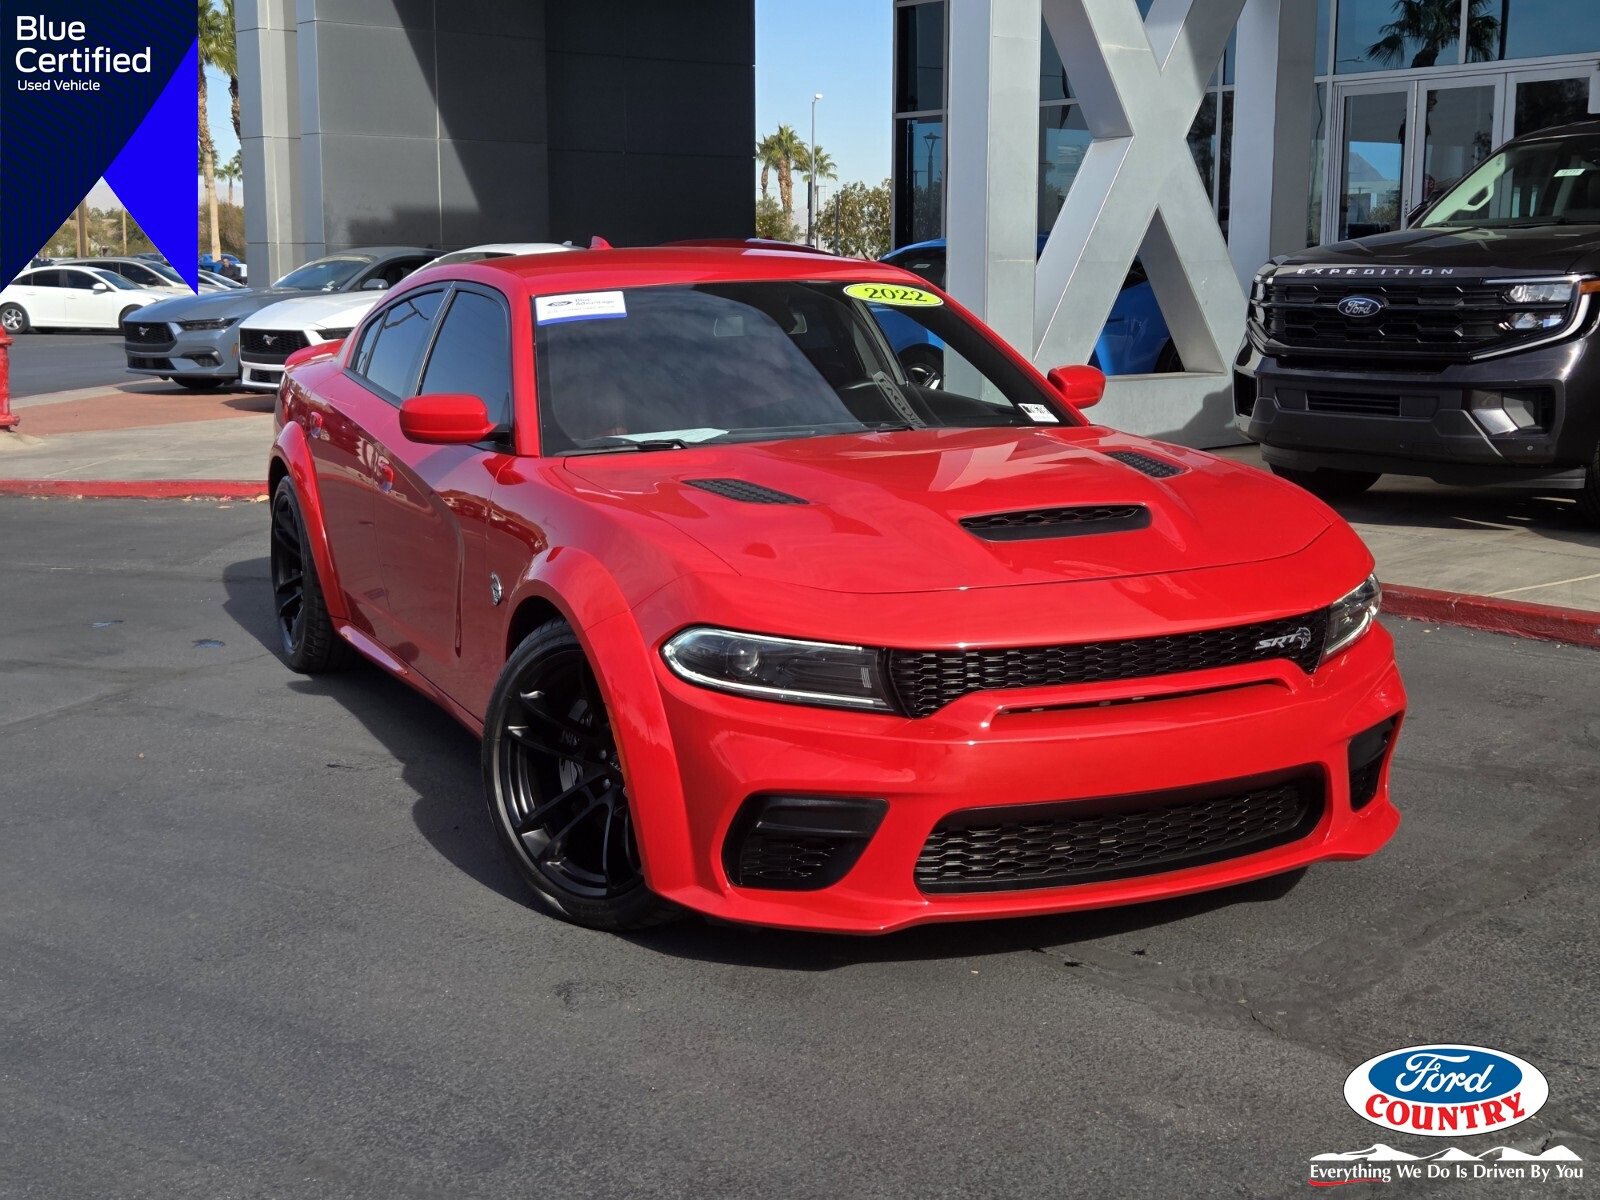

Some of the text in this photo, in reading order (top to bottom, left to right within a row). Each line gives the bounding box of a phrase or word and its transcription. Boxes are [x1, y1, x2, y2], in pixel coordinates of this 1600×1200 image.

[864, 287, 928, 302] 2022
[1345, 301, 1372, 314] Ford
[1255, 633, 1301, 650] SRT
